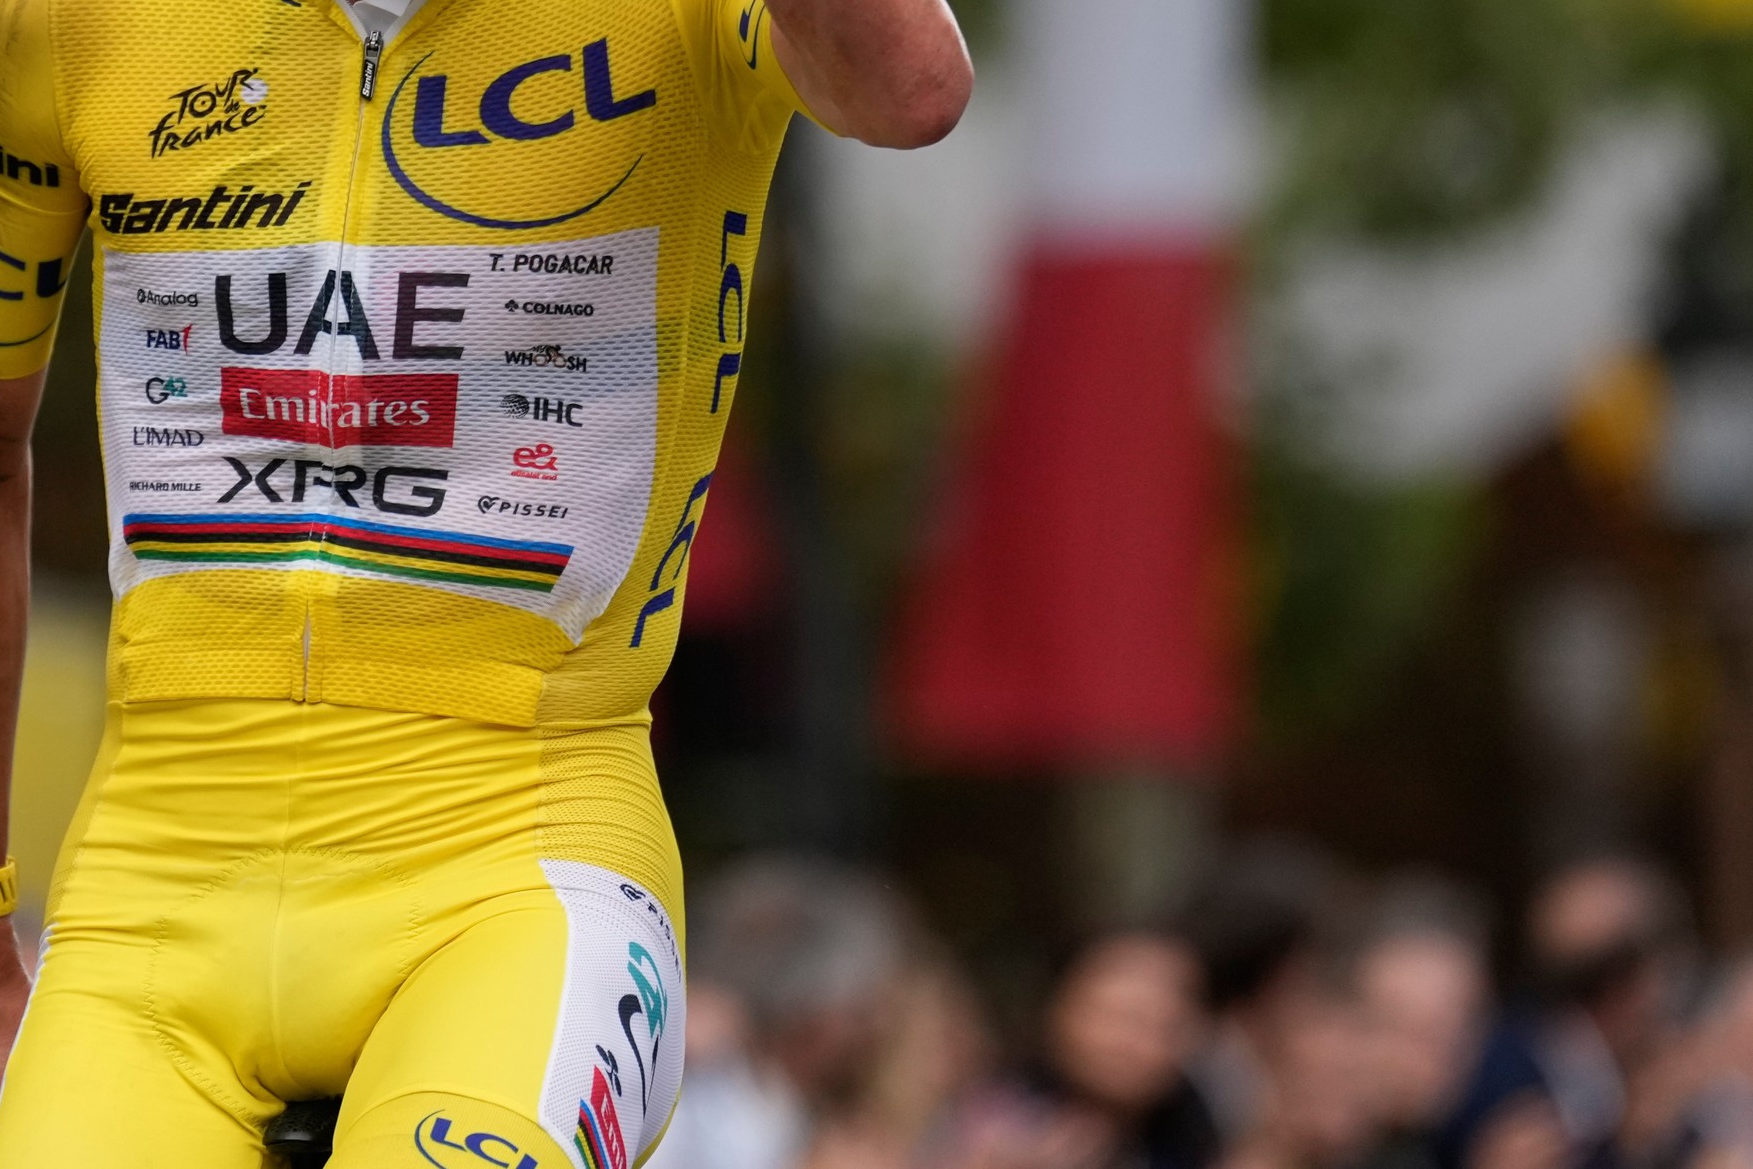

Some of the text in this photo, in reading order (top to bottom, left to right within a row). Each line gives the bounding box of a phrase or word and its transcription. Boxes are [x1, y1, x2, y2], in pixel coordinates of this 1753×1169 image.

[360, 62, 375, 98] Santini
[412, 37, 657, 149] LCL
[225, 98, 241, 114] de
[99, 180, 313, 235] Santini
[489, 254, 614, 275] T. POGACAR
[146, 290, 199, 307] Analog
[522, 301, 594, 317] COLNAGO
[708, 210, 747, 414] LCL
[214, 269, 471, 360] UAE
[504, 350, 587, 373] WHOOSH
[146, 377, 189, 405] G42
[239, 387, 431, 429] Emirates
[533, 396, 584, 428] IHC
[513, 443, 559, 471] e&
[129, 481, 202, 492] RICHARD MILLE
[216, 456, 450, 518] XRG
[498, 501, 569, 520] PISSEI
